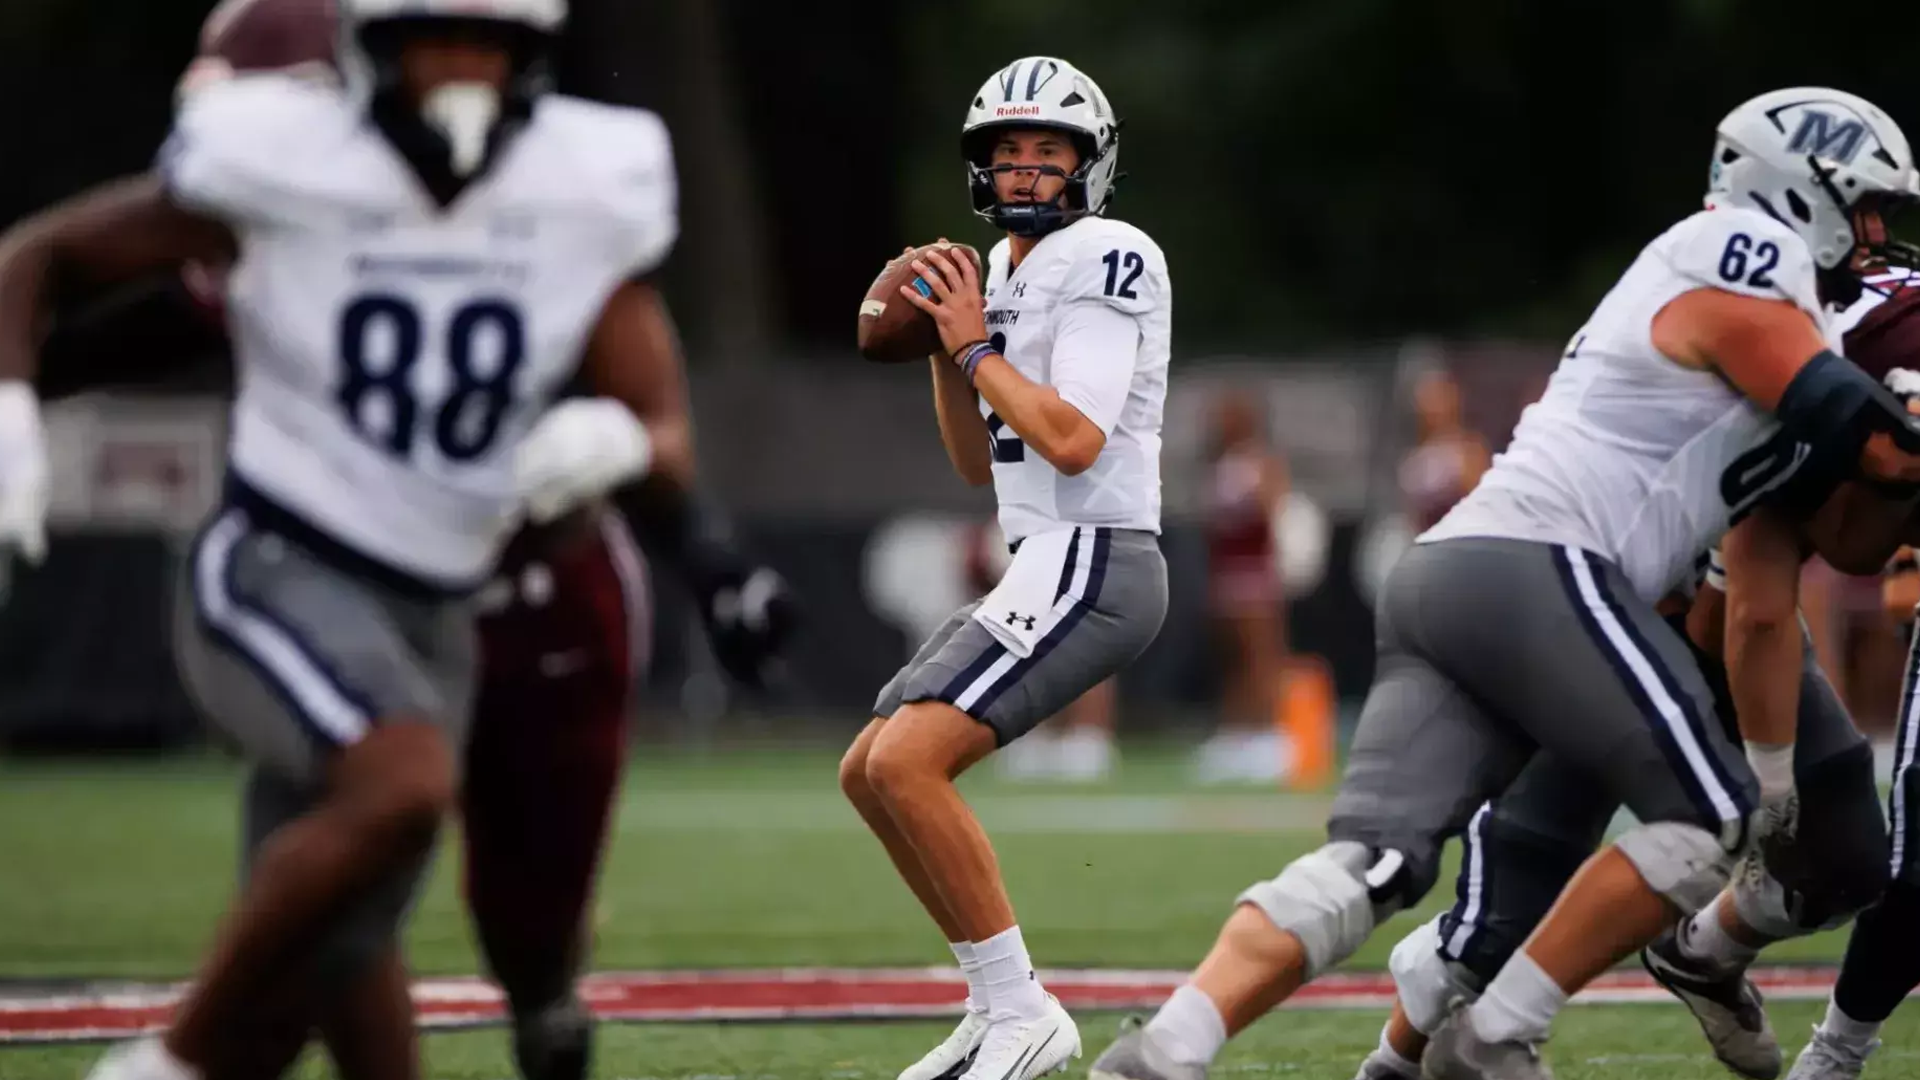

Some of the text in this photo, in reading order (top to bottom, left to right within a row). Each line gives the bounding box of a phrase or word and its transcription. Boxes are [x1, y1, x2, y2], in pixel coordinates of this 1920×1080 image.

[996, 106, 1039, 117] Riddell
[1786, 108, 1870, 165] M
[1102, 249, 1144, 300] 12
[1718, 232, 1780, 288] 62
[337, 293, 525, 463] 88
